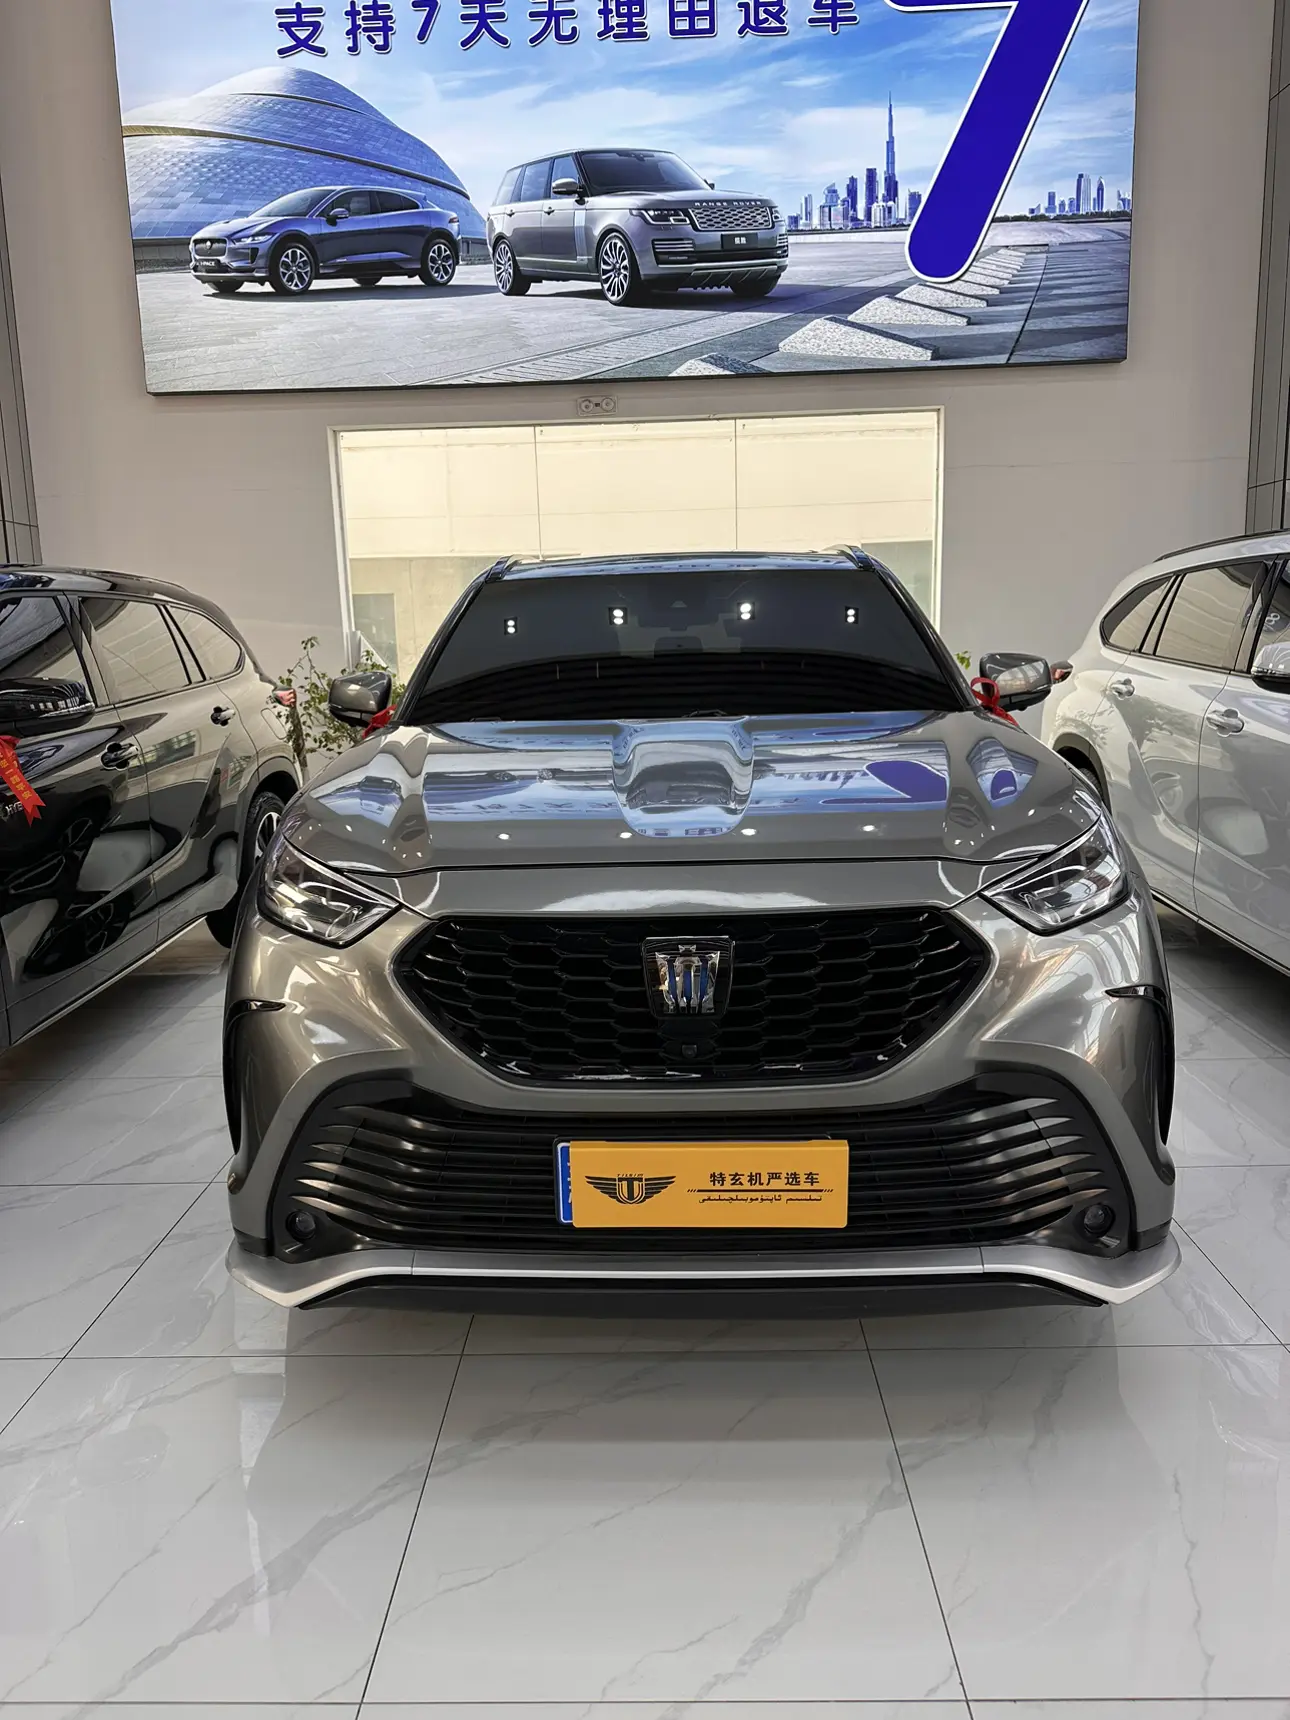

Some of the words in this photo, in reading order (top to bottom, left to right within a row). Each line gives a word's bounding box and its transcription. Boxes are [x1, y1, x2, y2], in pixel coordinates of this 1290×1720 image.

[275, 0, 859, 57] 支持7天无理由退车
[884, 0, 1089, 283] 7
[709, 1171, 820, 1187] 特玄机严选车
